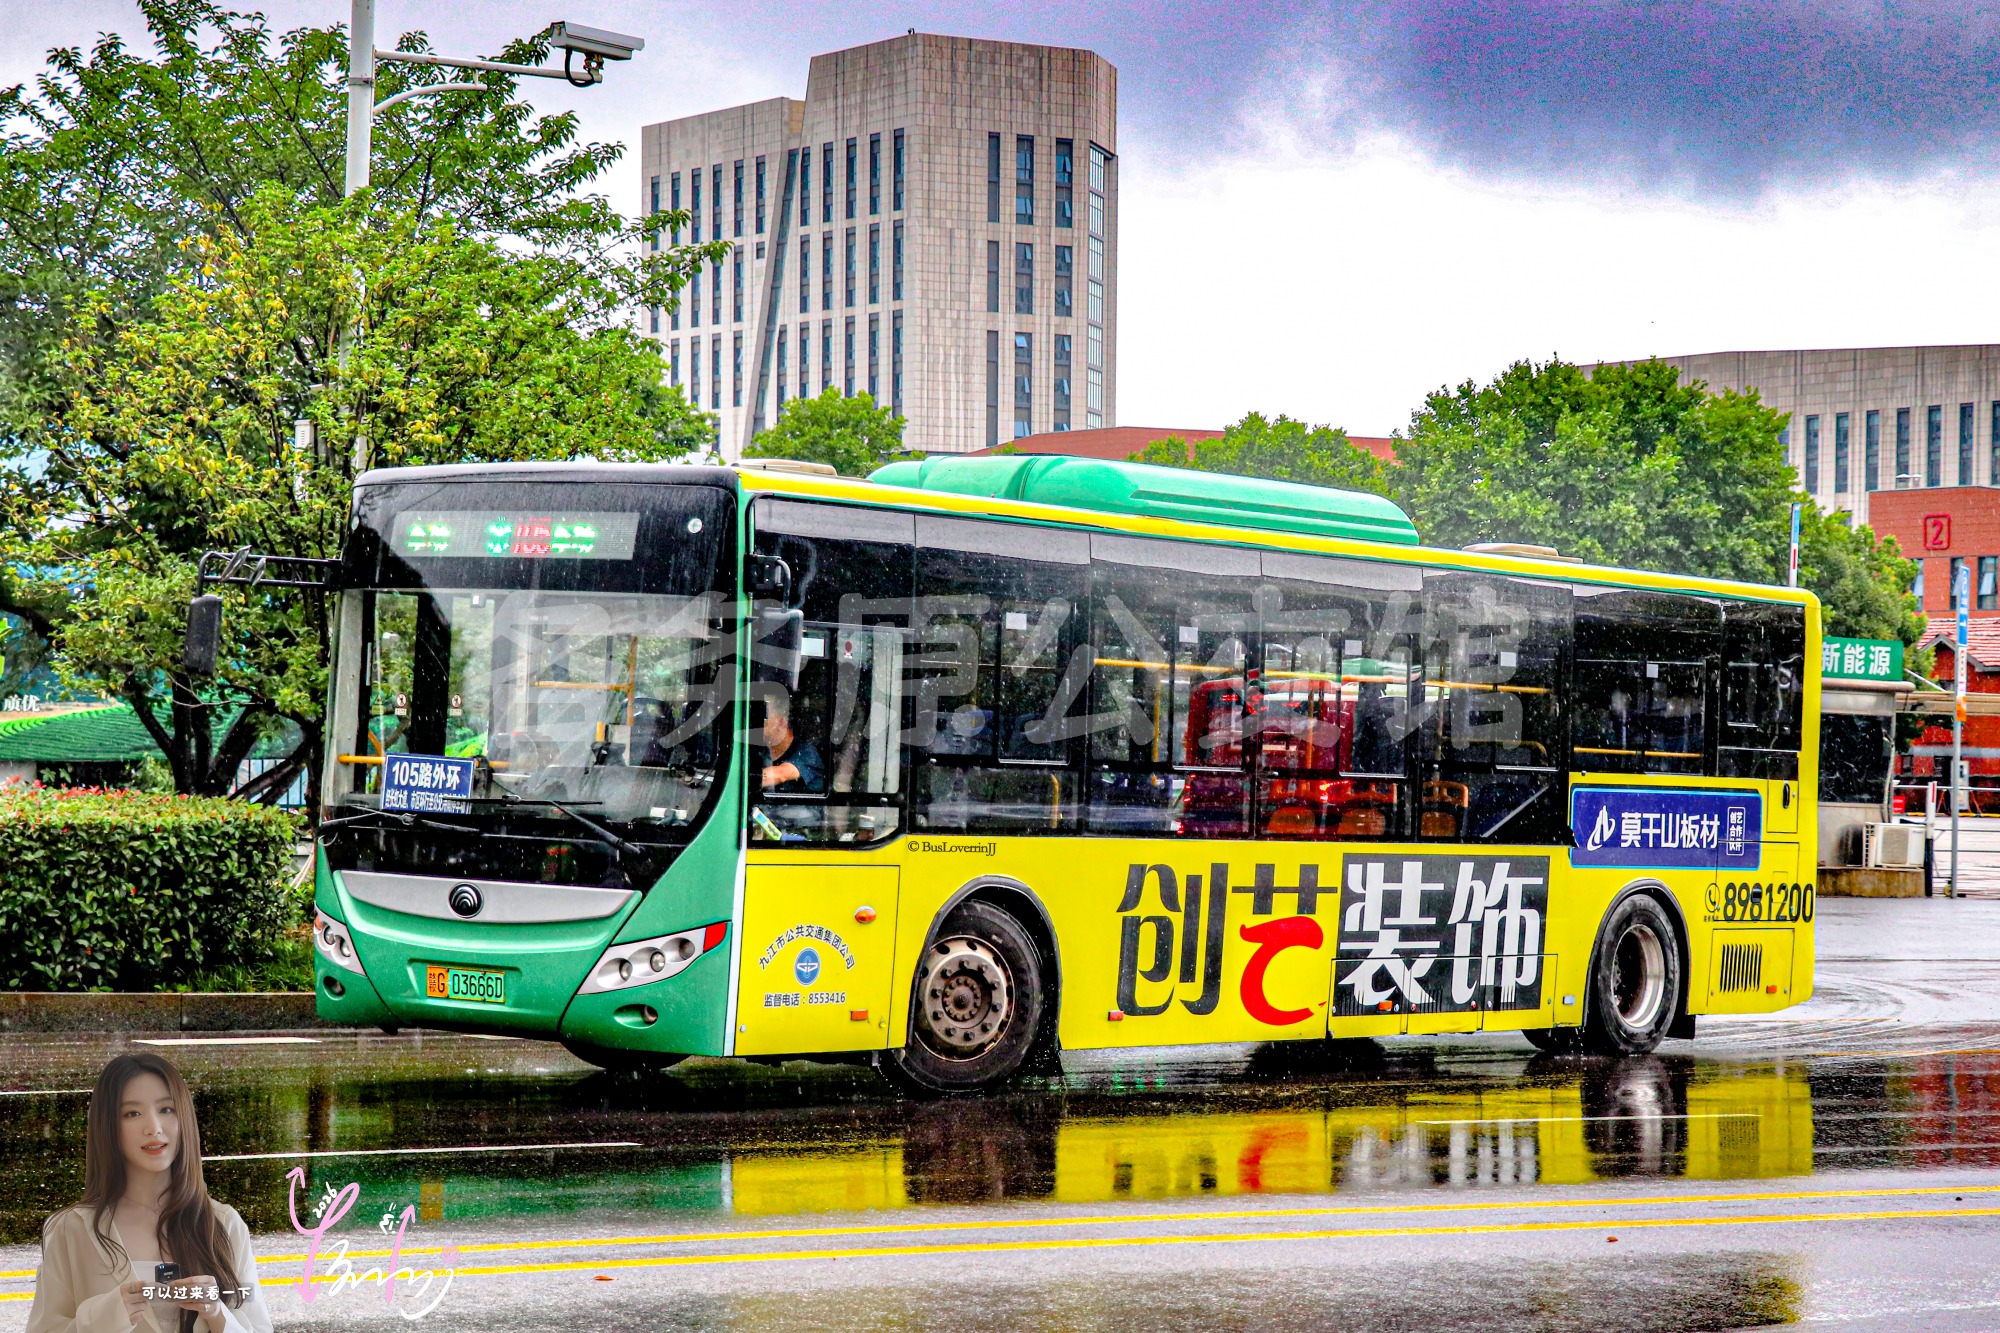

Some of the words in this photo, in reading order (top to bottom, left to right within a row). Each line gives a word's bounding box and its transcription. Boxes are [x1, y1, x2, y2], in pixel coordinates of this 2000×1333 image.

[1931, 519, 1943, 545] 2
[1822, 641, 1891, 676] 新能源
[392, 761, 461, 790] 105路外环
[1620, 811, 1720, 849] 莫干山板材
[1723, 882, 1814, 923] 8981200
[759, 924, 855, 971] 九江市公共交通集团公司
